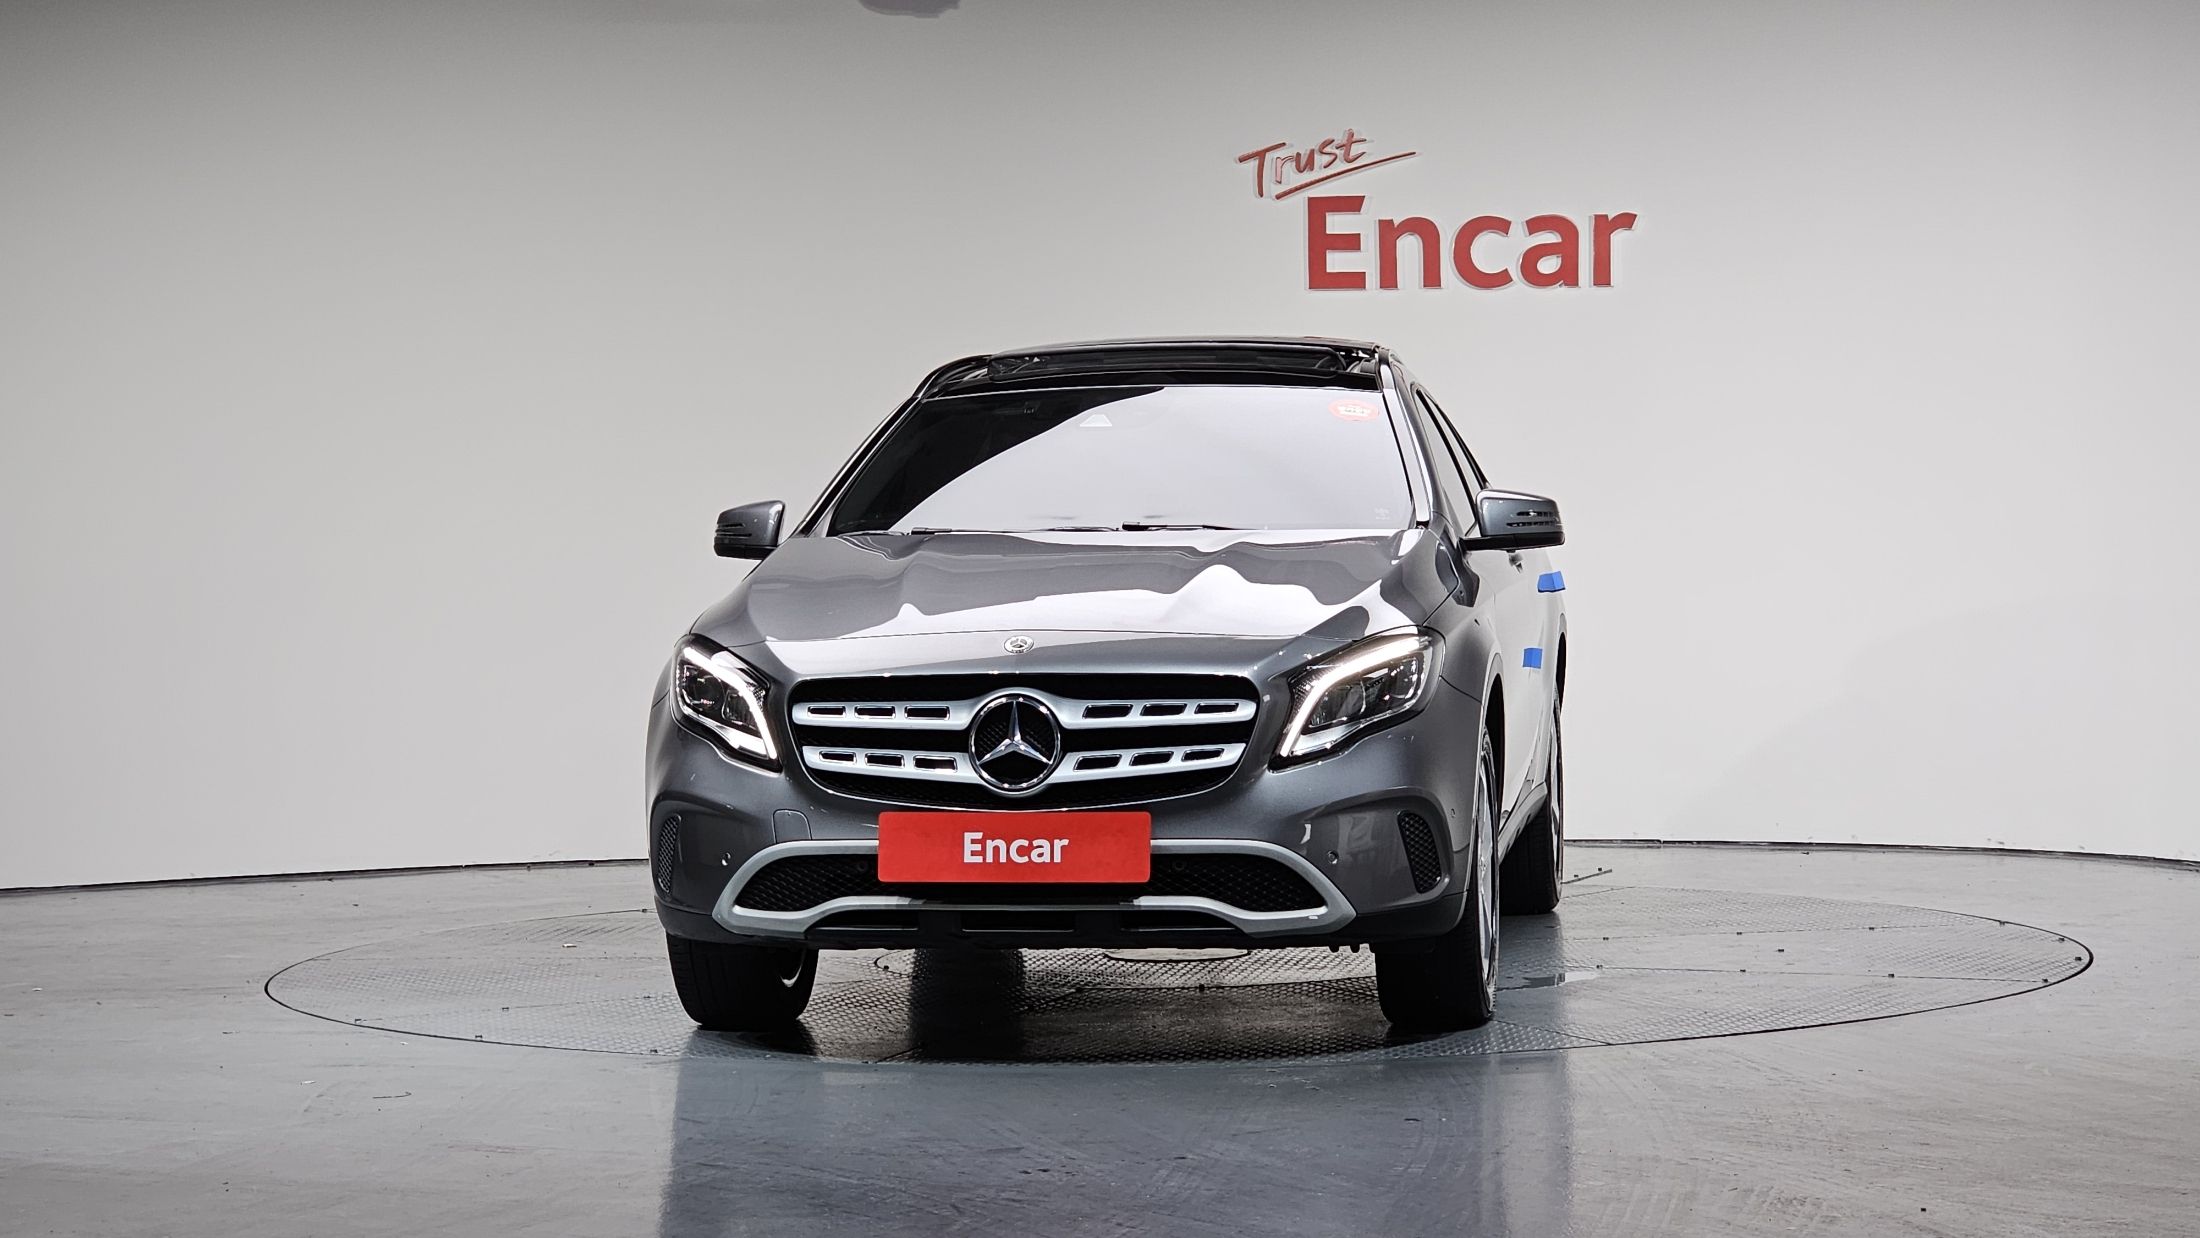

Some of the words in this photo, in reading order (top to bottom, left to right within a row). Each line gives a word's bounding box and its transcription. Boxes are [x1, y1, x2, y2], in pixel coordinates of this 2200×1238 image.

[1238, 128, 1368, 198] Trust
[1307, 195, 1638, 290] Encar
[963, 831, 1069, 864] Encar
